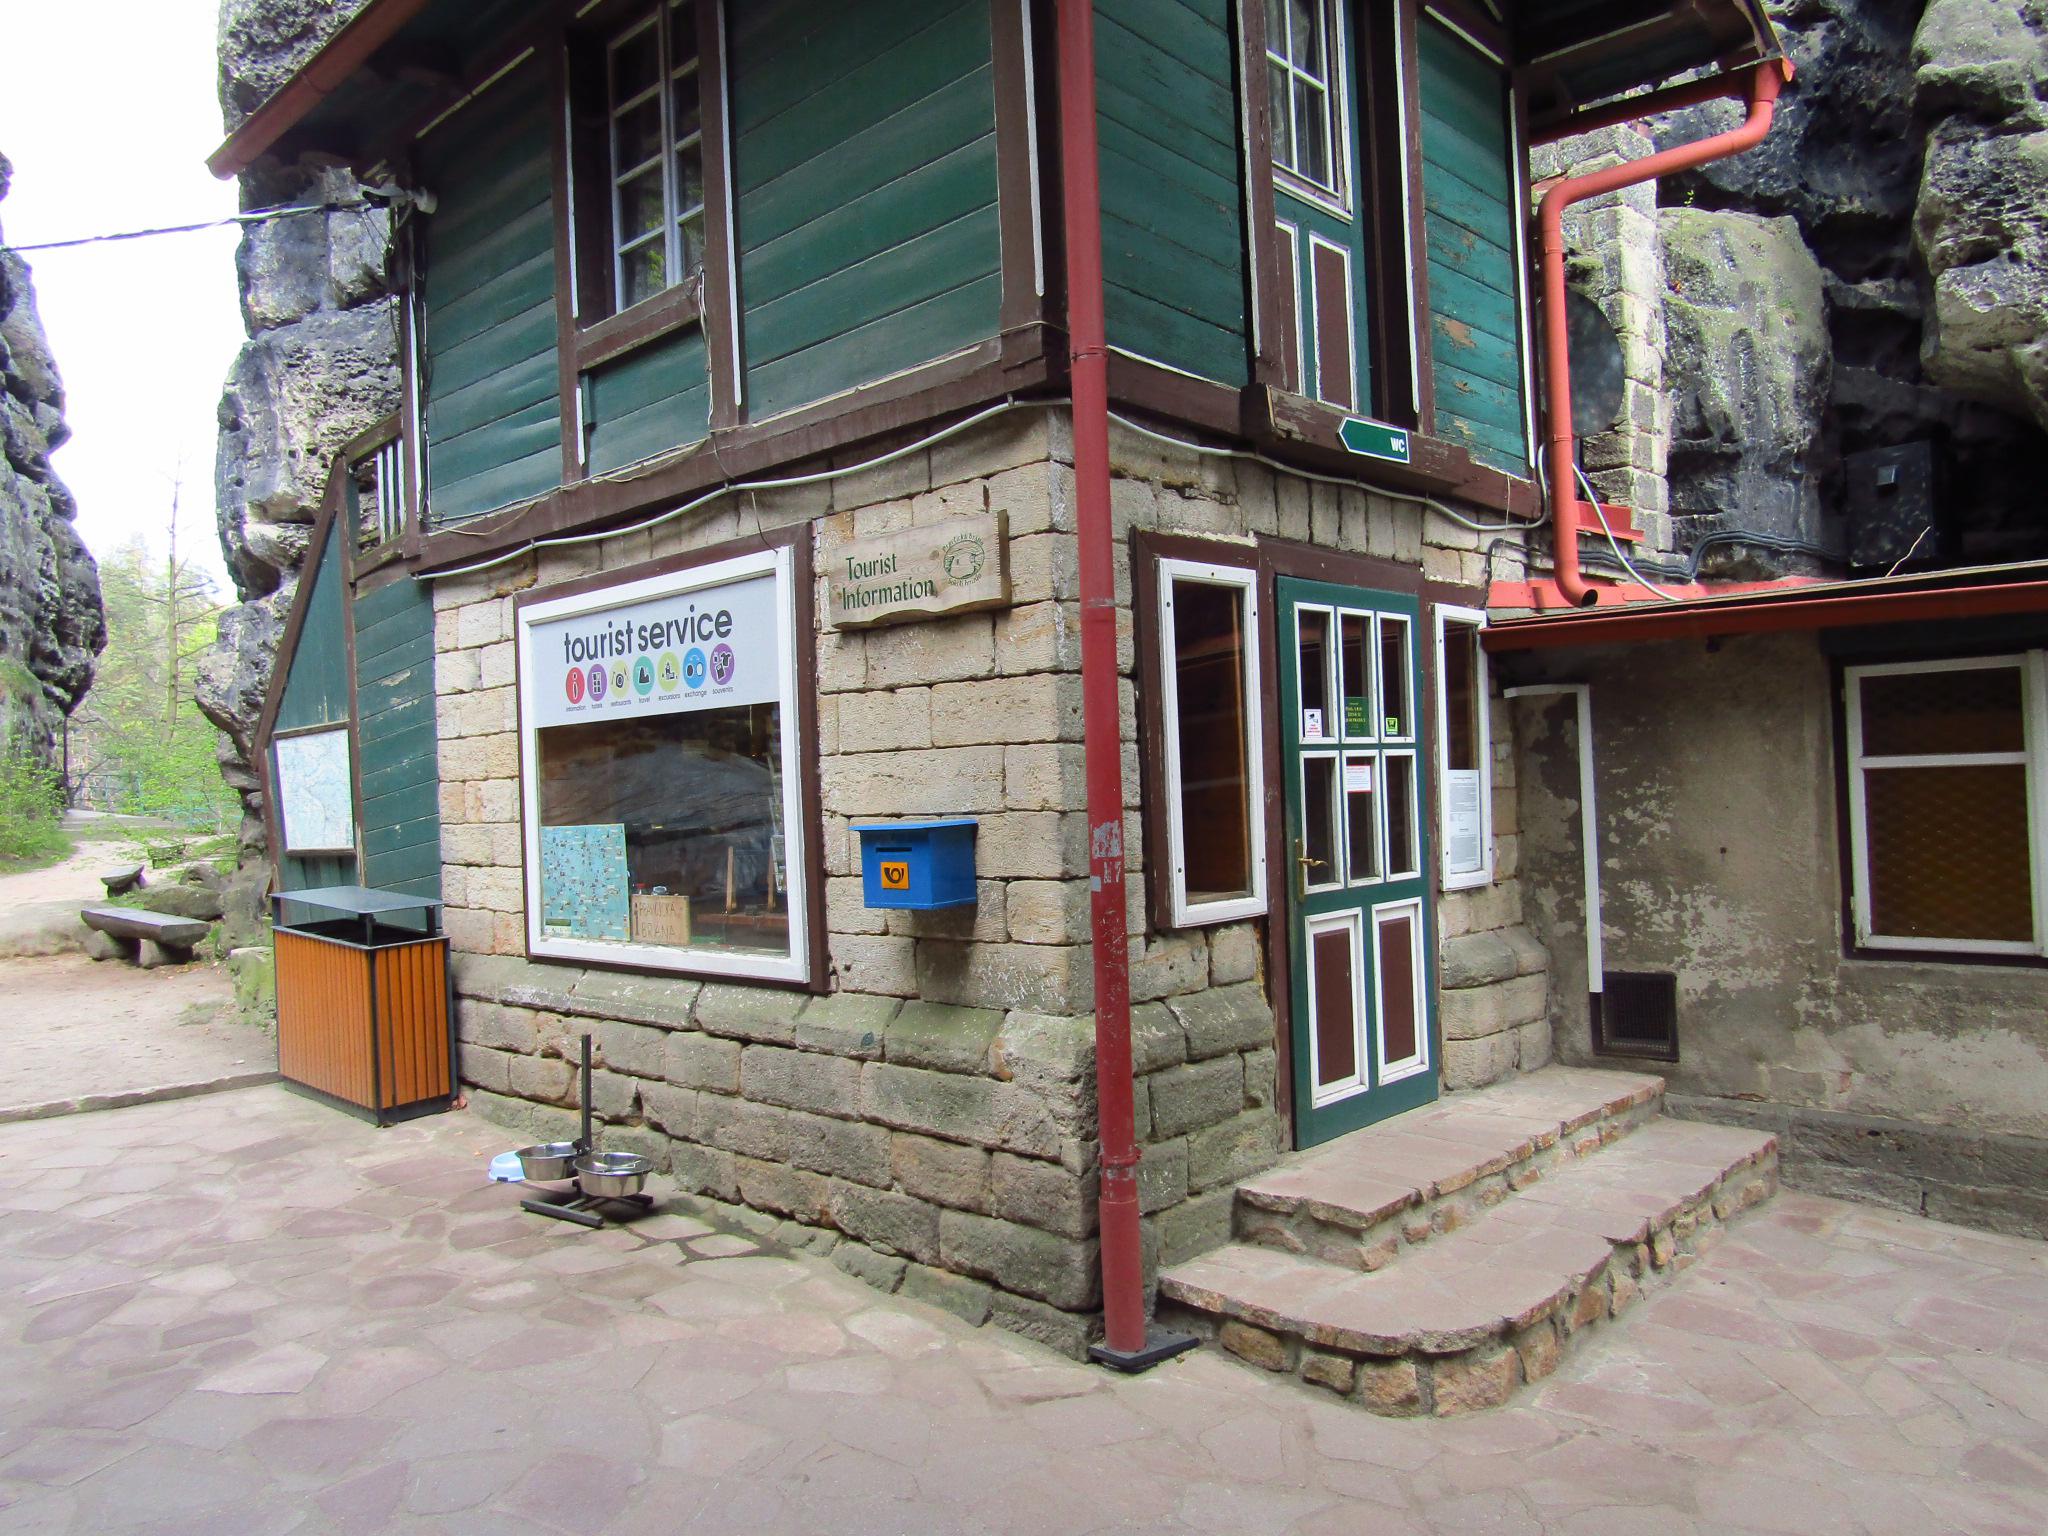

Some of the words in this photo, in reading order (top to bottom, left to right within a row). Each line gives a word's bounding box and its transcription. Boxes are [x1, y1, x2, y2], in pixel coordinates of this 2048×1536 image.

[1391, 437, 1406, 453] WC
[846, 552, 898, 581] Tourist
[842, 577, 935, 610] Information
[564, 620, 633, 664] tourist
[638, 604, 733, 652] service
[658, 693, 681, 701] excursions
[684, 690, 708, 698] exchange
[712, 686, 734, 695] souvenirs
